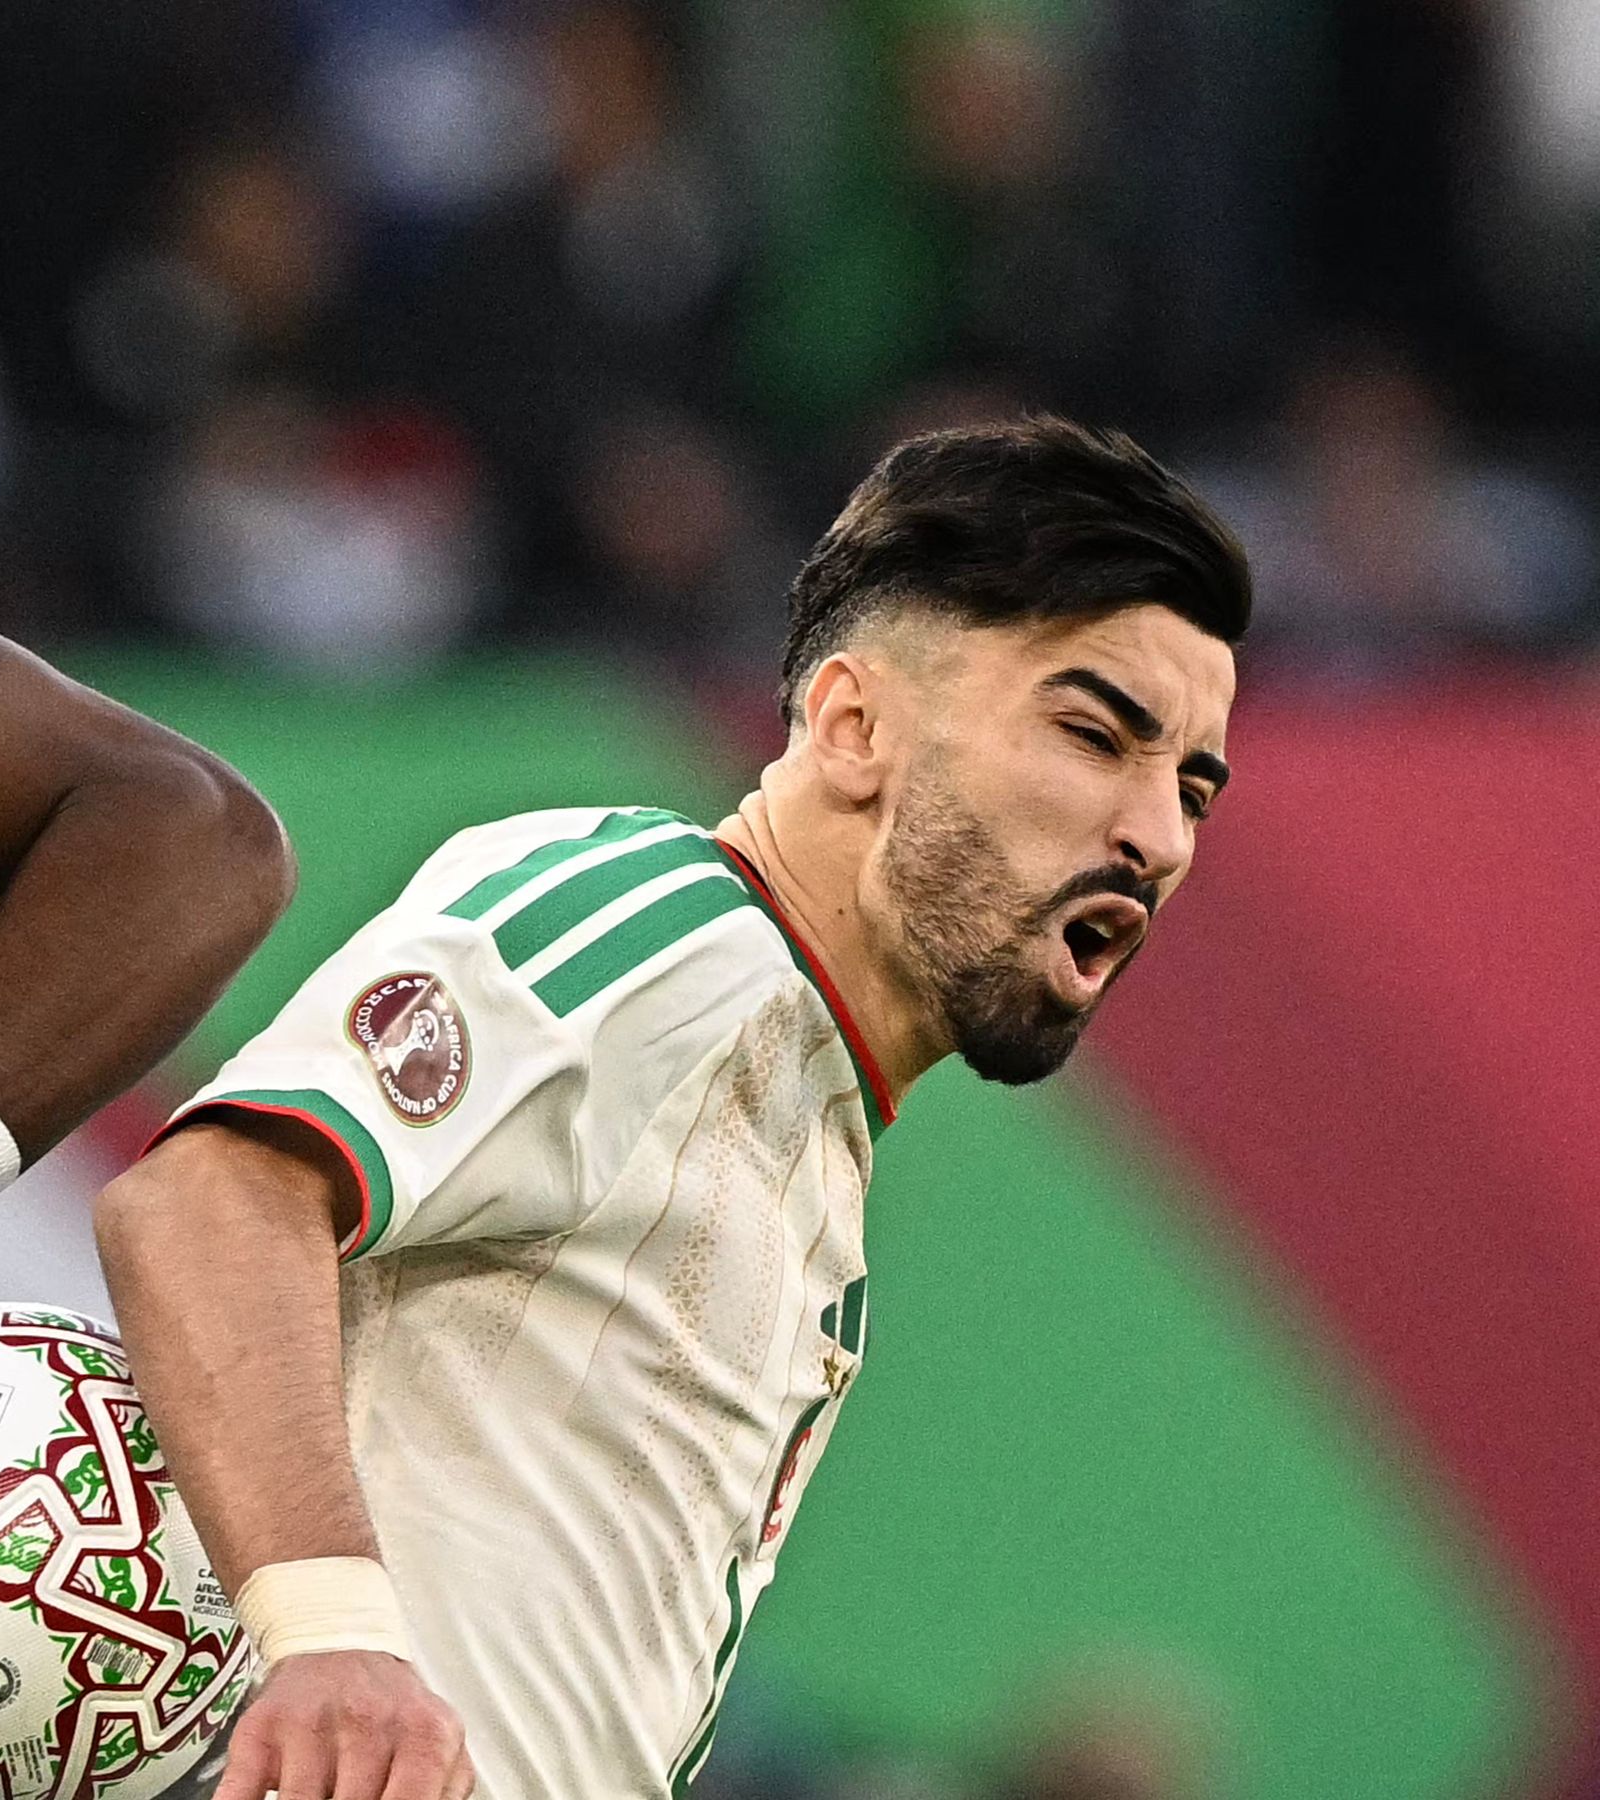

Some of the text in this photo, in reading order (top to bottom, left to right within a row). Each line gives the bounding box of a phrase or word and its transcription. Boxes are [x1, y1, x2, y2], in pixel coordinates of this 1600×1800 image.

[355, 1006, 386, 1071] MOROCCO
[381, 1015, 462, 1115] AFRICA CUP OF NATIONS
